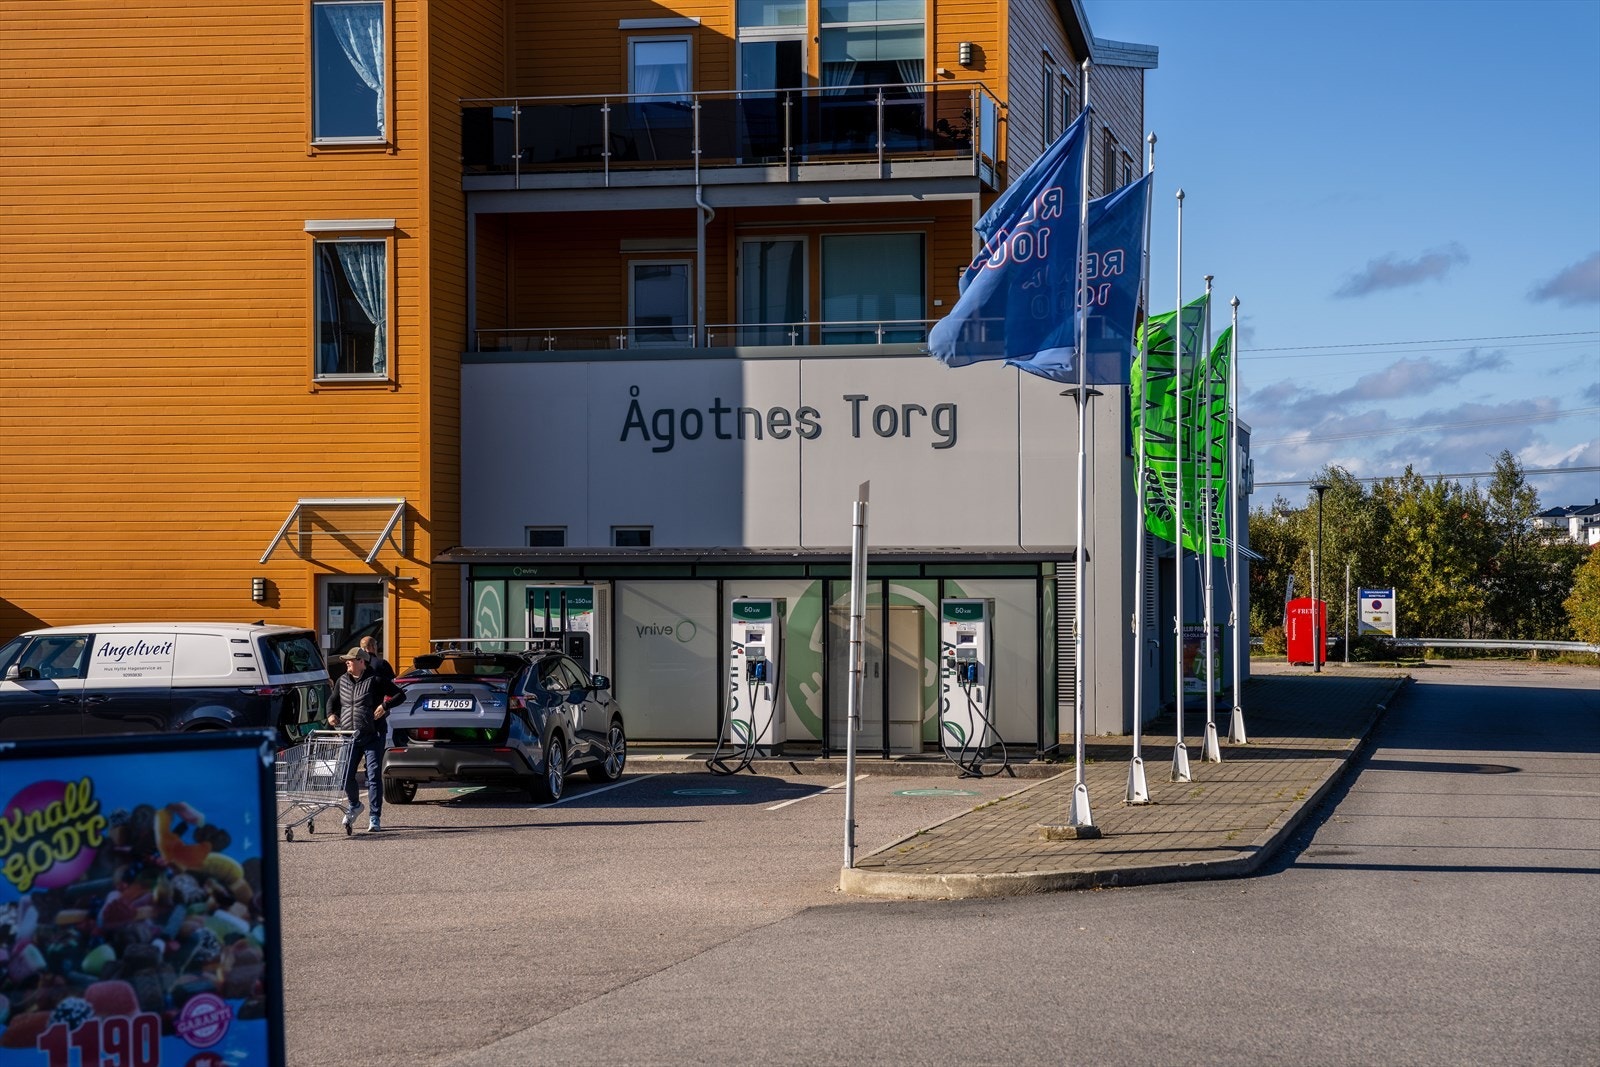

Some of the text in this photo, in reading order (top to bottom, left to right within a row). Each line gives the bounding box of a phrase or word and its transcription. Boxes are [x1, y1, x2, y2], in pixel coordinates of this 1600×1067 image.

[620, 384, 958, 454] Ågotnes Torg
[97, 640, 173, 662] Angeltveit
[431, 699, 470, 708] EJ 47069
[0, 777, 98, 857] Knall
